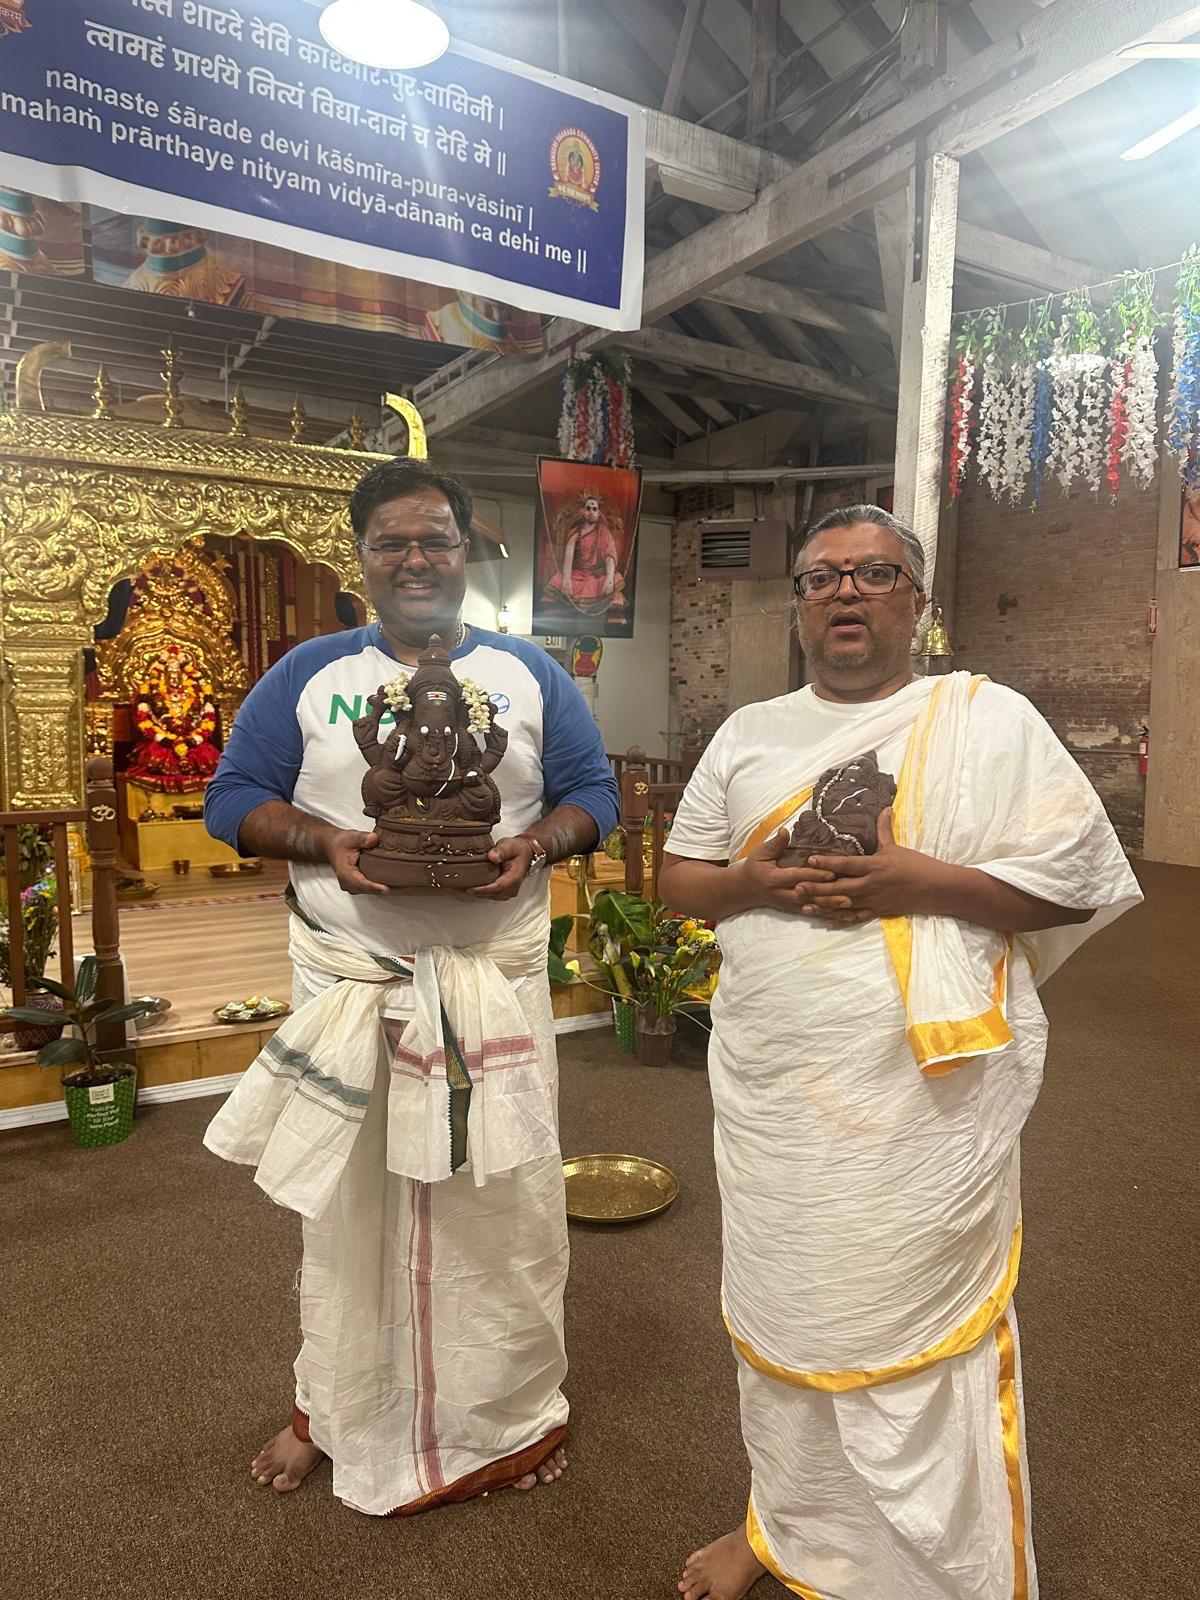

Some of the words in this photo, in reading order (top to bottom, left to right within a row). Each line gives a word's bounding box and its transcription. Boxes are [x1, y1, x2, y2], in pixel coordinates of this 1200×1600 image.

[183, 0, 245, 42] शारदे
[250, 16, 292, 56] देवि
[46, 69, 160, 118] namaste
[167, 101, 253, 145] śārade
[260, 129, 309, 161] devi
[84, 19, 166, 69] त्वामहं
[172, 47, 242, 90] प्रार्थये
[247, 66, 305, 110] नित्यं
[412, 123, 431, 148] च
[435, 125, 469, 163] देहि
[473, 138, 492, 168] मे
[111, 120, 235, 172] prārthaye
[242, 157, 321, 196] nityam
[471, 222, 493, 243] ca
[499, 228, 539, 256] dehi
[545, 242, 572, 265] me
